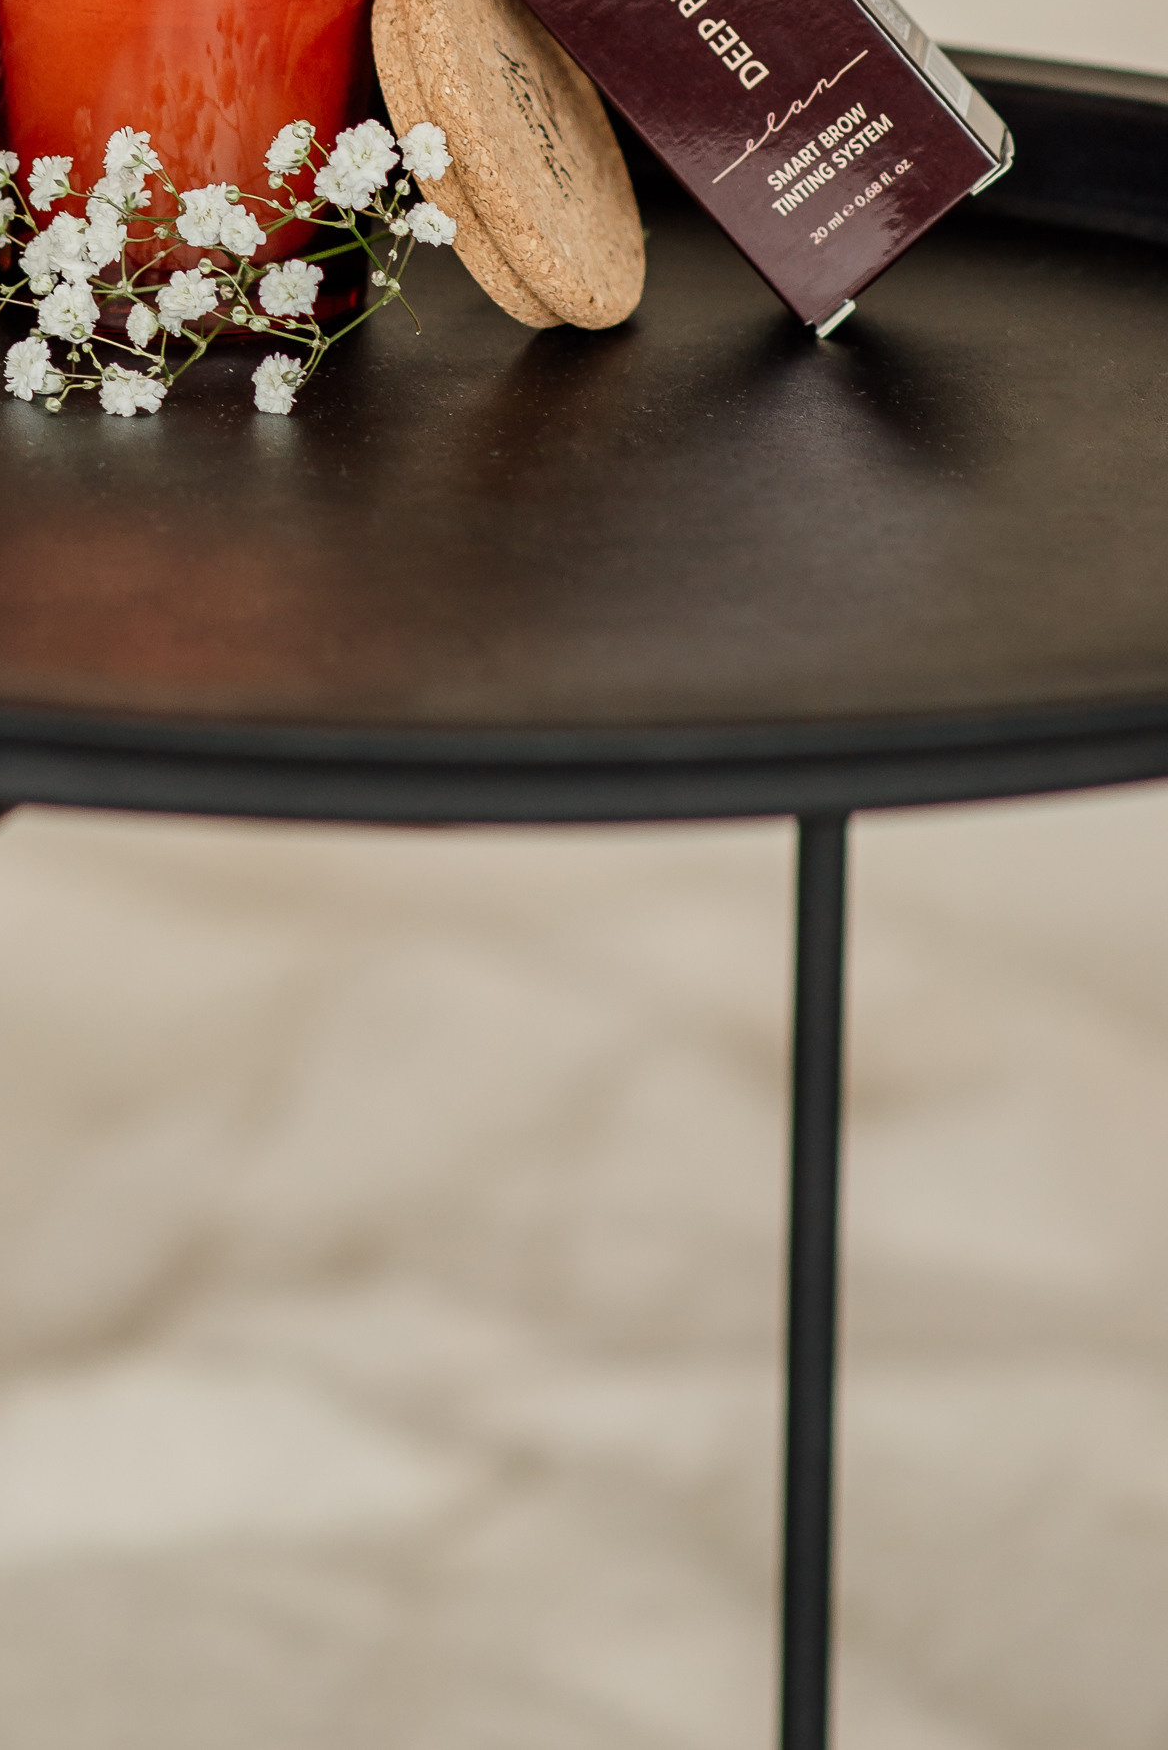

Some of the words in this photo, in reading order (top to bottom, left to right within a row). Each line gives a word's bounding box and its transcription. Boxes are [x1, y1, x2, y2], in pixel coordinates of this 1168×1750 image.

[698, 18, 770, 91] DEEP
[712, 49, 869, 184] elan
[767, 140, 822, 192] SMART
[817, 102, 867, 150] BROW
[771, 162, 836, 217] TINTING
[832, 113, 894, 169] SYSTEM
[809, 225, 828, 245] 20
[827, 211, 845, 231] ml
[879, 171, 896, 187] fl.
[894, 158, 914, 176] oz.
